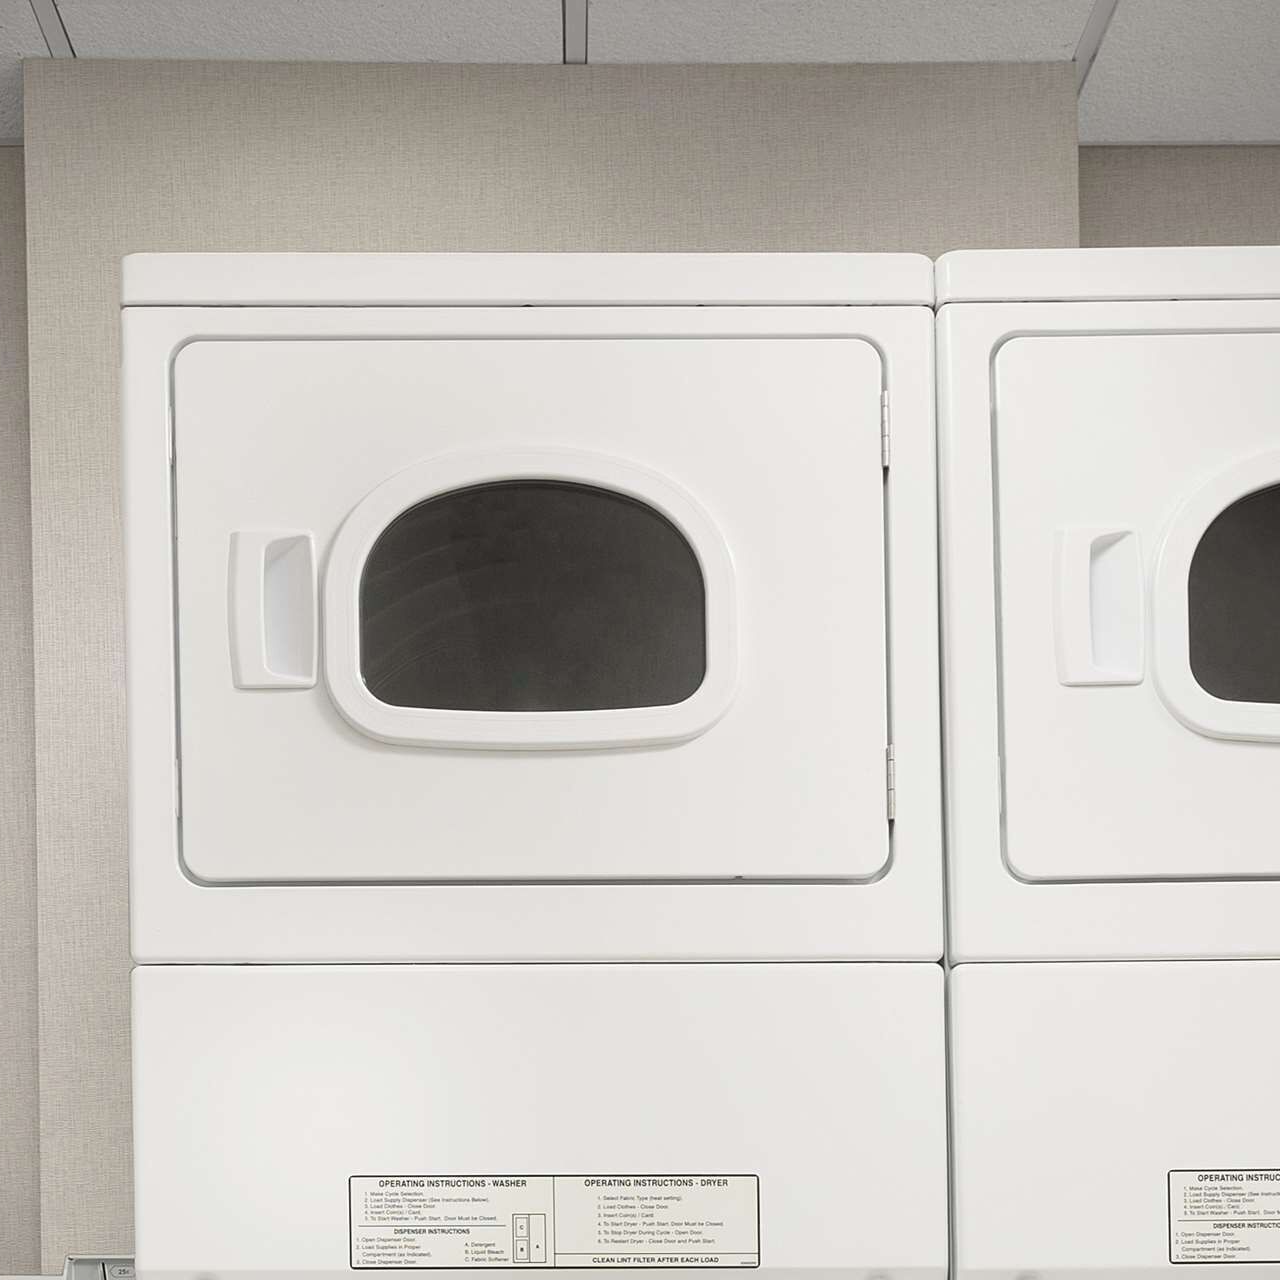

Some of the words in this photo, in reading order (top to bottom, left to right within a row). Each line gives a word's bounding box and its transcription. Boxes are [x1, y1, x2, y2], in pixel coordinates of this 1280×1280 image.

[1197, 1174, 1244, 1182] OPERATING
[378, 1180, 425, 1188] OPERATING
[427, 1179, 486, 1187] INSTRUCTIONS
[492, 1179, 527, 1187] WASHER
[584, 1179, 631, 1187] OPERATING
[634, 1179, 693, 1187] INSTRUCTIONS
[700, 1179, 728, 1187] DRYER
